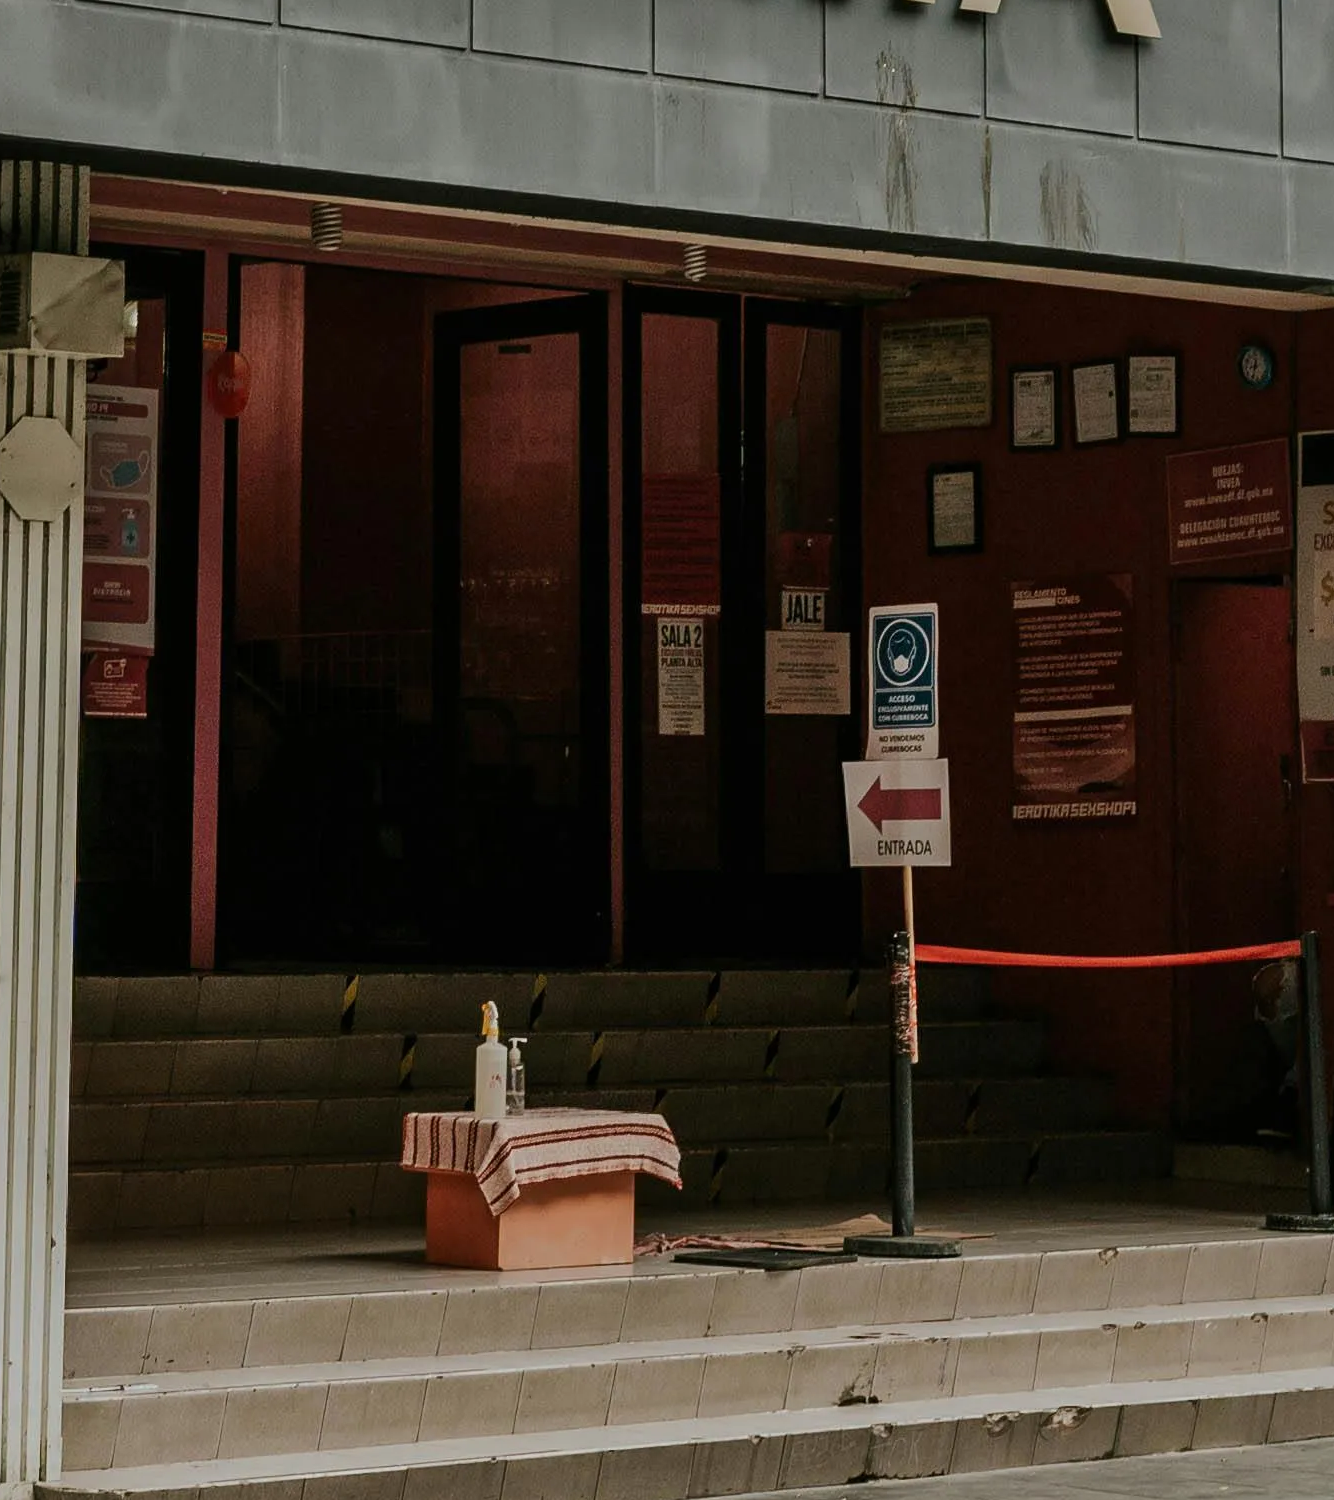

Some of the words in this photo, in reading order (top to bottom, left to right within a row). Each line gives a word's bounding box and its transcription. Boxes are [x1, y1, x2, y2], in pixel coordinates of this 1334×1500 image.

[786, 594, 822, 623] JALE
[661, 624, 692, 648] SALA
[694, 624, 703, 648] 2
[888, 694, 915, 703] ACCESO
[877, 838, 932, 857] ENTRADA
